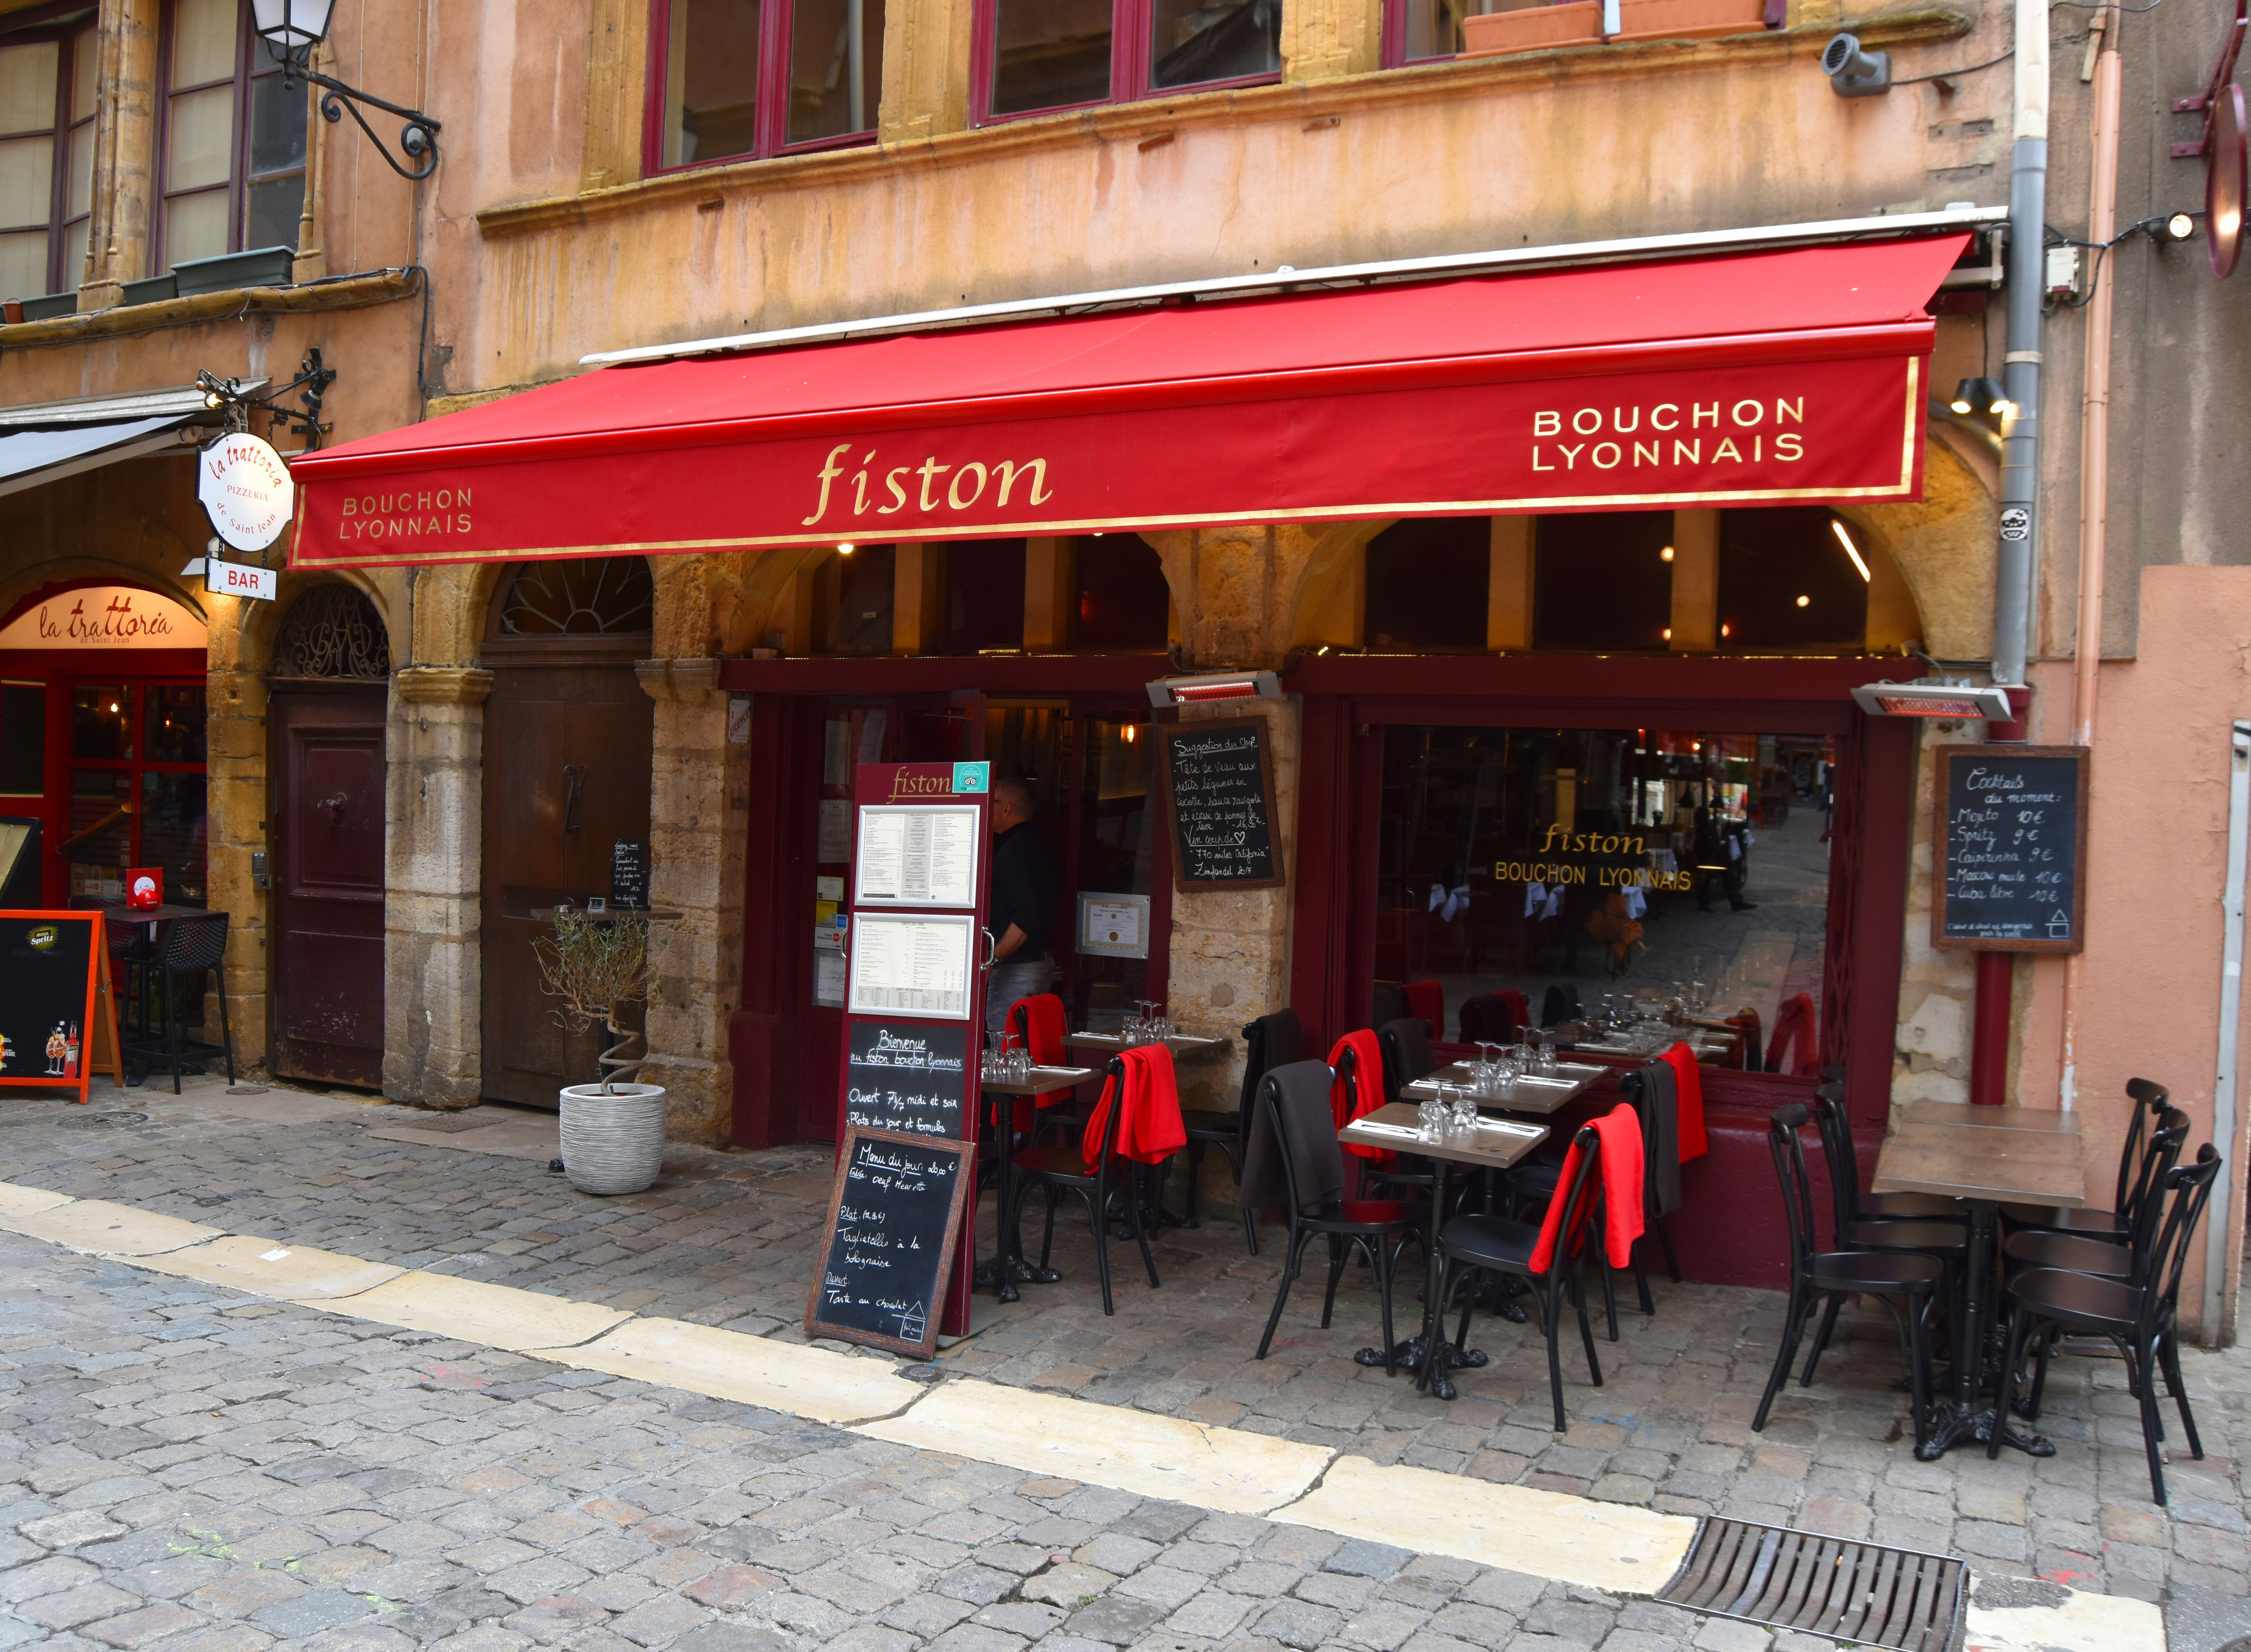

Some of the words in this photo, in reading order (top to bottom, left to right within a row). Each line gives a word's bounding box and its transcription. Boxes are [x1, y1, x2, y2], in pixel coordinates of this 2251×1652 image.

[1534, 396, 1803, 436] BOUCHON
[1532, 433, 1804, 471] LYONNAIS
[209, 459, 226, 480] la
[227, 445, 282, 488] trattoria
[227, 485, 268, 501] PIZZERIA
[801, 443, 1052, 525] fiston
[343, 488, 470, 516] BOUCHON
[217, 502, 227, 516] de
[229, 518, 254, 534] Saint
[258, 514, 276, 533] Jean
[340, 514, 471, 539] LYONNAIS
[228, 570, 259, 589] BAR
[40, 606, 61, 638] la
[67, 595, 173, 638] trattoria
[730, 710, 749, 736] LICENCE
[1174, 737, 1223, 759] Suggestion
[1225, 739, 1237, 748] du
[1240, 736, 1256, 751] Chef
[1203, 761, 1213, 773] de
[1239, 762, 1256, 771] aux
[886, 766, 951, 804] fiston
[1175, 778, 1198, 795] petits
[1201, 777, 1234, 796] légumes
[1967, 767, 2025, 790] Cocktails
[1208, 797, 1231, 806] sauce
[1233, 795, 1261, 811] ravigote
[1984, 793, 2003, 804] du
[1180, 810, 1190, 822] et
[1192, 809, 1213, 820] écrasé
[1215, 811, 1222, 821] de
[1224, 811, 1246, 824] pommes
[1196, 821, 1214, 831] terre
[1184, 825, 1202, 844] Vin
[1205, 836, 1223, 850] coup
[1224, 831, 1234, 843] de
[1539, 823, 1647, 854] fiston
[1214, 848, 1232, 859] miles
[1195, 862, 1233, 880] Zinfandel
[1495, 862, 1586, 884] BOUCHON
[1600, 867, 1691, 890] LYONNAIS
[1999, 870, 2026, 882] mule
[1990, 884, 2015, 898] libre
[31, 936, 53, 945] Spritz
[877, 1030, 927, 1050] Bienvenue
[851, 1053, 862, 1062] au
[866, 1048, 889, 1063] fiston
[895, 1051, 924, 1067] bouchon
[928, 1052, 961, 1072] lyonnais
[849, 1087, 881, 1103] Ouvert
[907, 1094, 927, 1105] midi
[930, 1093, 939, 1106] et
[873, 1115, 883, 1125] du
[886, 1118, 901, 1130] jour
[905, 1117, 914, 1129] et
[860, 1143, 886, 1167] Menu
[888, 1152, 901, 1167] du
[838, 1226, 888, 1250] Tagliatelles
[897, 1239, 905, 1248] à
[911, 1235, 921, 1249] la
[844, 1250, 892, 1269] bolognaise
[827, 1290, 851, 1304] Tarte
